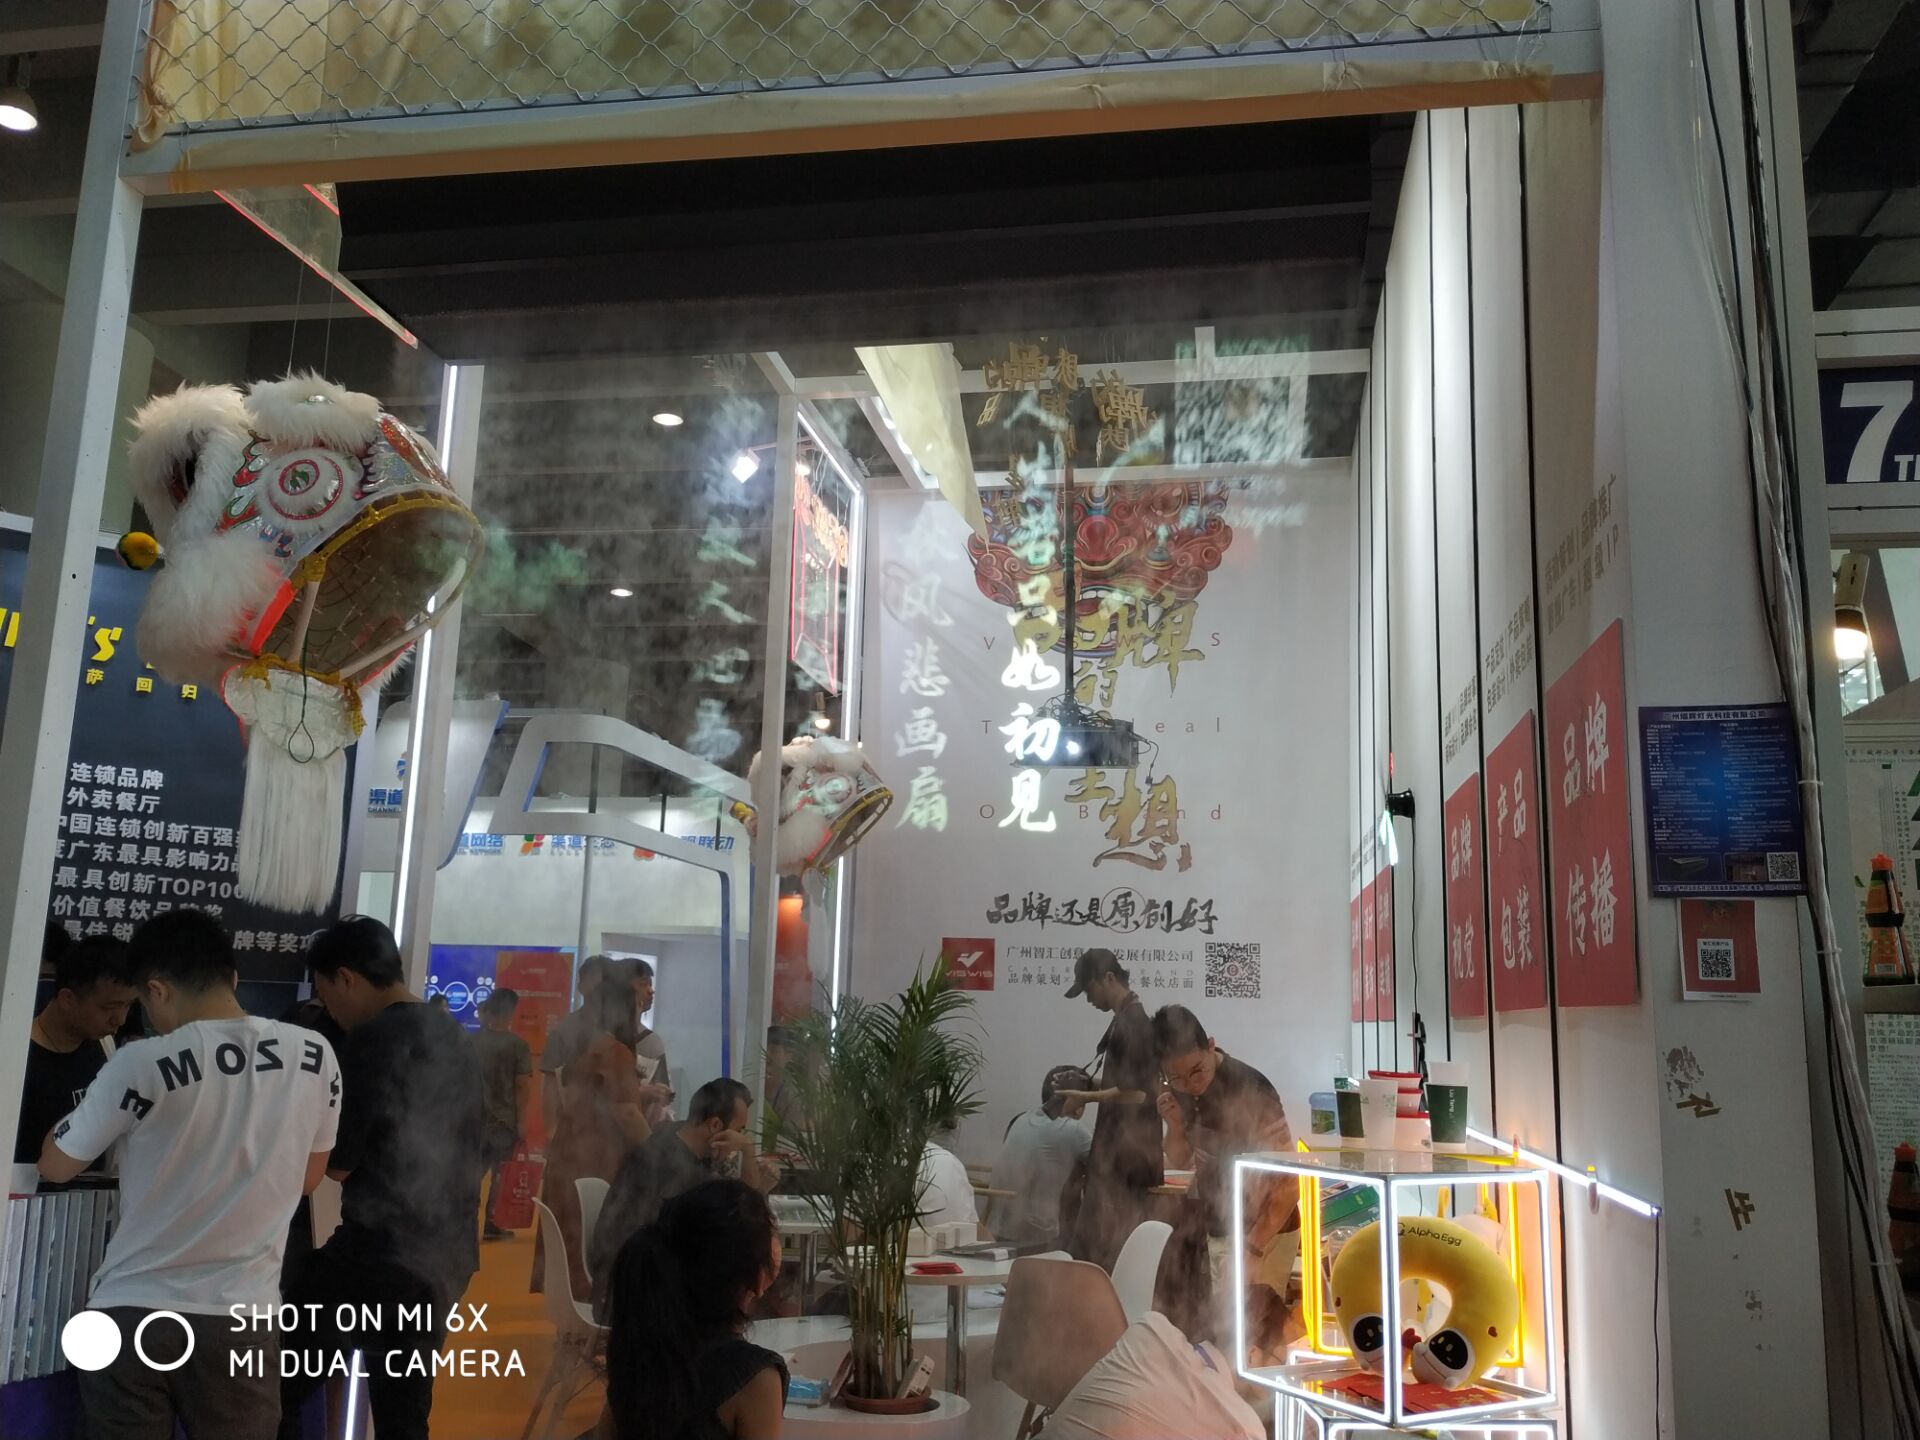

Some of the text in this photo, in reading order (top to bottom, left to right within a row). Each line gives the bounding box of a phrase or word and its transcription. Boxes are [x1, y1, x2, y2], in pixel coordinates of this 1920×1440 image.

[1563, 690, 1609, 809] 品牌
[70, 761, 164, 791] 连锁品牌
[67, 786, 161, 814] 外卖餐厅
[1407, 1226, 1462, 1247] AlphaEgg
